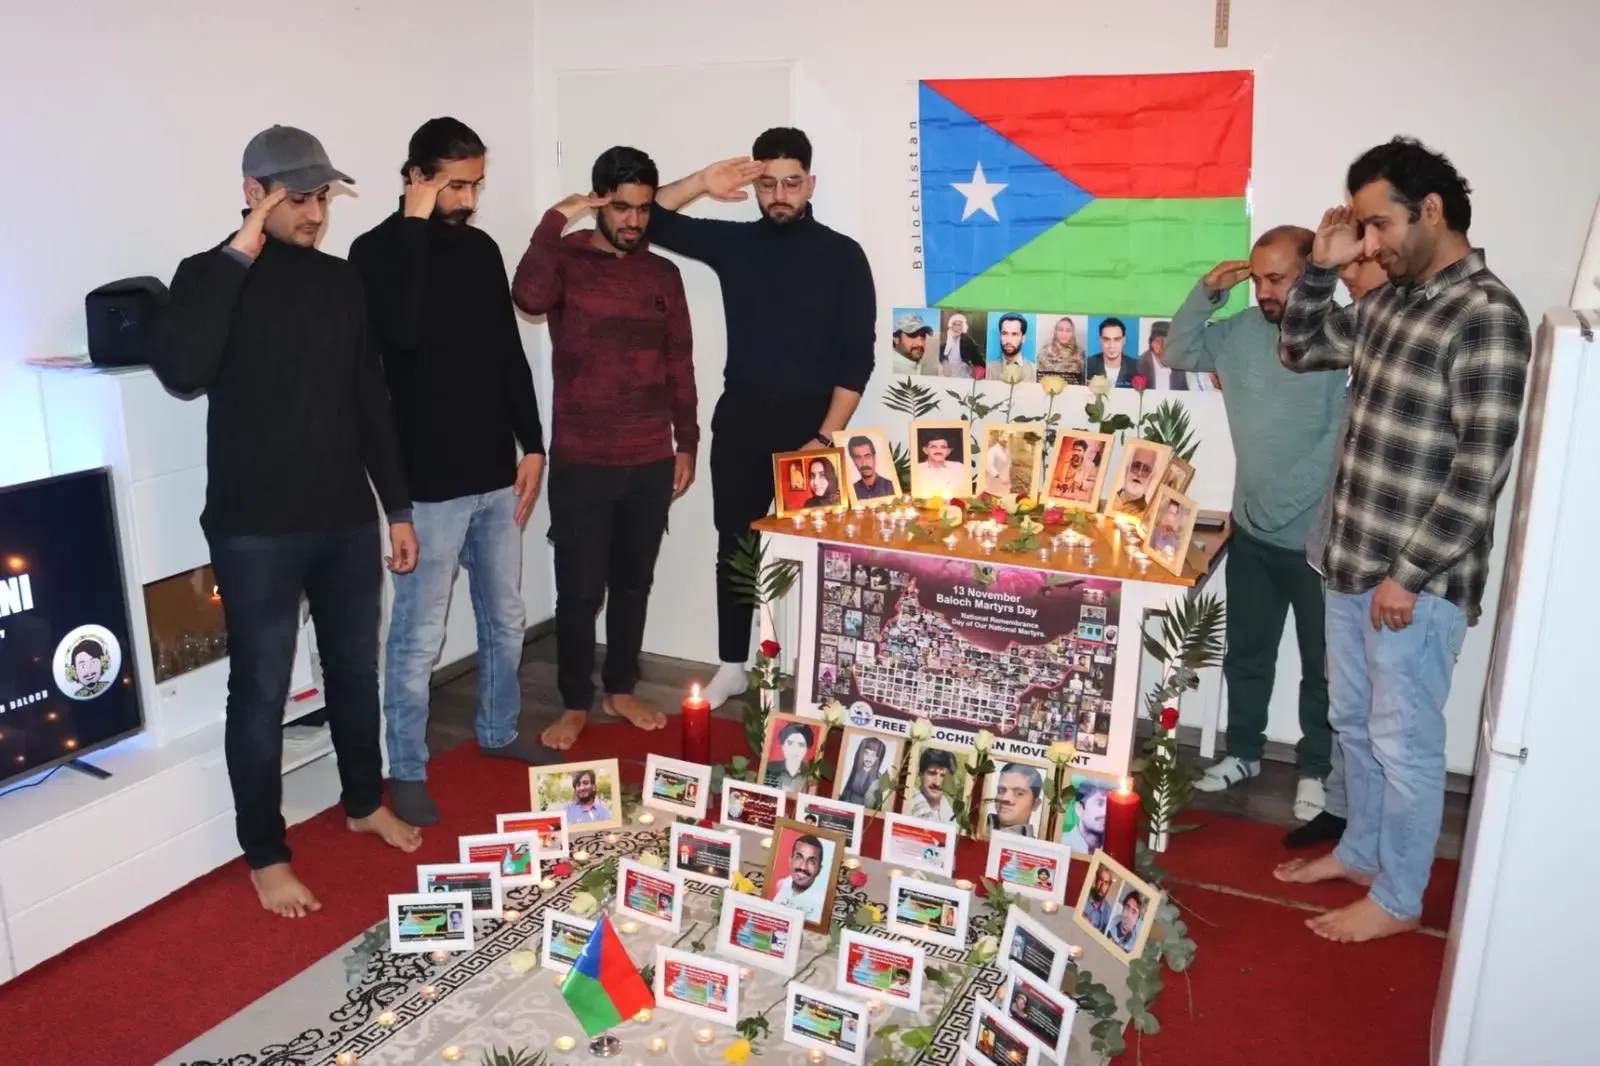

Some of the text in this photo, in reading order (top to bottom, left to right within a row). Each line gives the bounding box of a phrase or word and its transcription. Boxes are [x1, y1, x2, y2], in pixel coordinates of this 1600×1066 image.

[909, 121, 923, 270] Balochistan
[953, 585, 1021, 603] 13 November
[936, 594, 1038, 618] Baloch Martyrs Day
[951, 618, 965, 627] Day
[974, 621, 987, 629] Our
[988, 623, 1017, 633] National
[960, 612, 989, 622] National
[874, 719, 907, 733] FREE
[1009, 743, 1091, 766] MOVENT
